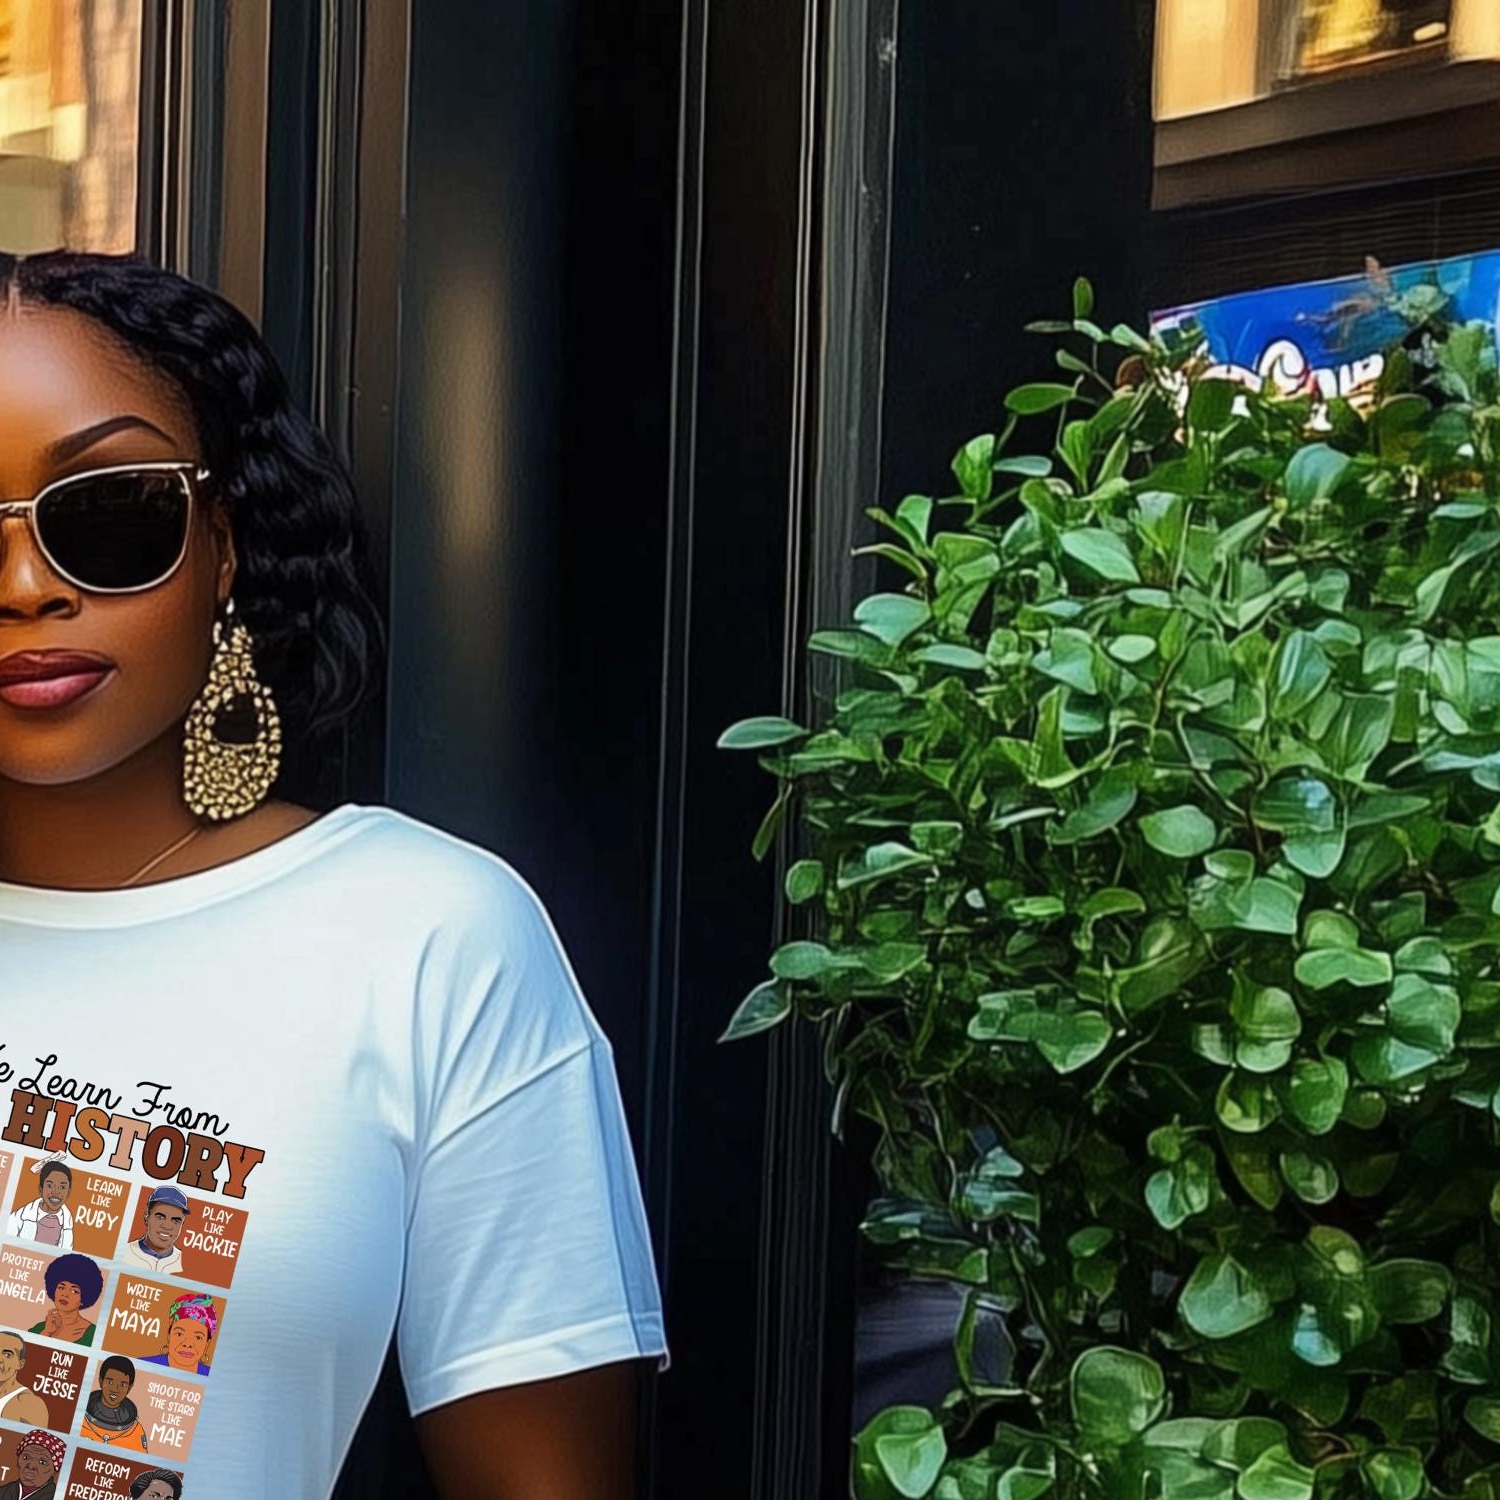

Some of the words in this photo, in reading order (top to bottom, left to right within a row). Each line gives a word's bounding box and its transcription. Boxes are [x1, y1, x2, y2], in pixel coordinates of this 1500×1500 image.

[18, 1054, 122, 1110] Learn
[132, 1081, 230, 1136] From
[1, 1088, 265, 1199] HISTORY
[86, 1177, 123, 1197] LEARN
[90, 1194, 111, 1208] LIKE
[75, 1205, 119, 1232] RUBY
[202, 1205, 234, 1224] PLAY
[203, 1221, 225, 1236] LIKE
[183, 1230, 239, 1259] JACKIE
[1, 1251, 45, 1272] PROTEST
[8, 1267, 30, 1282] LIKE
[126, 1281, 163, 1301] WRITE
[130, 1297, 152, 1312] LIKE
[110, 1308, 161, 1338] MAYA
[51, 1350, 73, 1368] RUN
[48, 1366, 70, 1380] LIKE
[33, 1374, 78, 1400] JESSE
[147, 1381, 181, 1399] SHOOT
[181, 1389, 201, 1405] FOR
[150, 1396, 166, 1411] THE
[168, 1401, 195, 1417] STARS
[161, 1412, 183, 1426] LIKE
[150, 1423, 187, 1448] MAE
[85, 1457, 131, 1480] REFORM
[93, 1475, 115, 1489] LIKE
